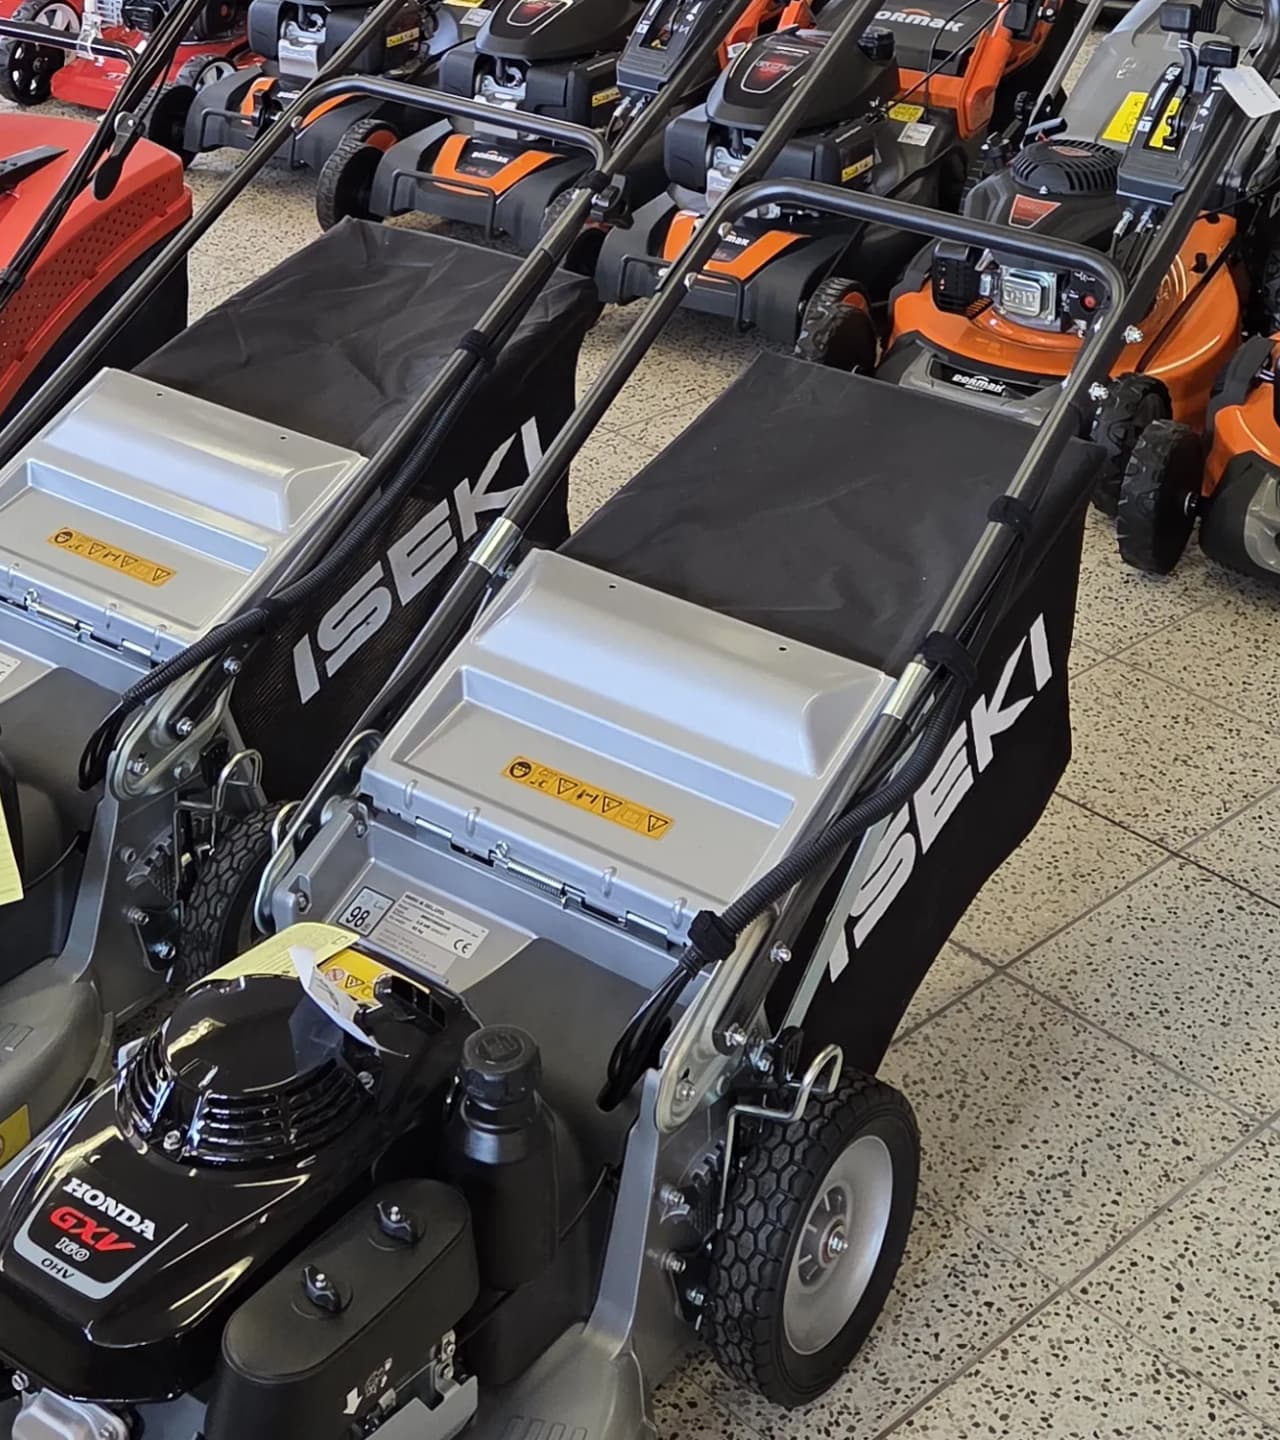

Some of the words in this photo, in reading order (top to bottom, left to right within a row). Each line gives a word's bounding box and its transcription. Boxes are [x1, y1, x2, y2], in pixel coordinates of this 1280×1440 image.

[293, 417, 546, 706] ISEKI
[346, 906, 370, 929] 98
[61, 1176, 157, 1242] HONDA
[49, 1205, 137, 1255] GXV
[54, 1237, 91, 1263] 160
[41, 1257, 76, 1282] OHV
